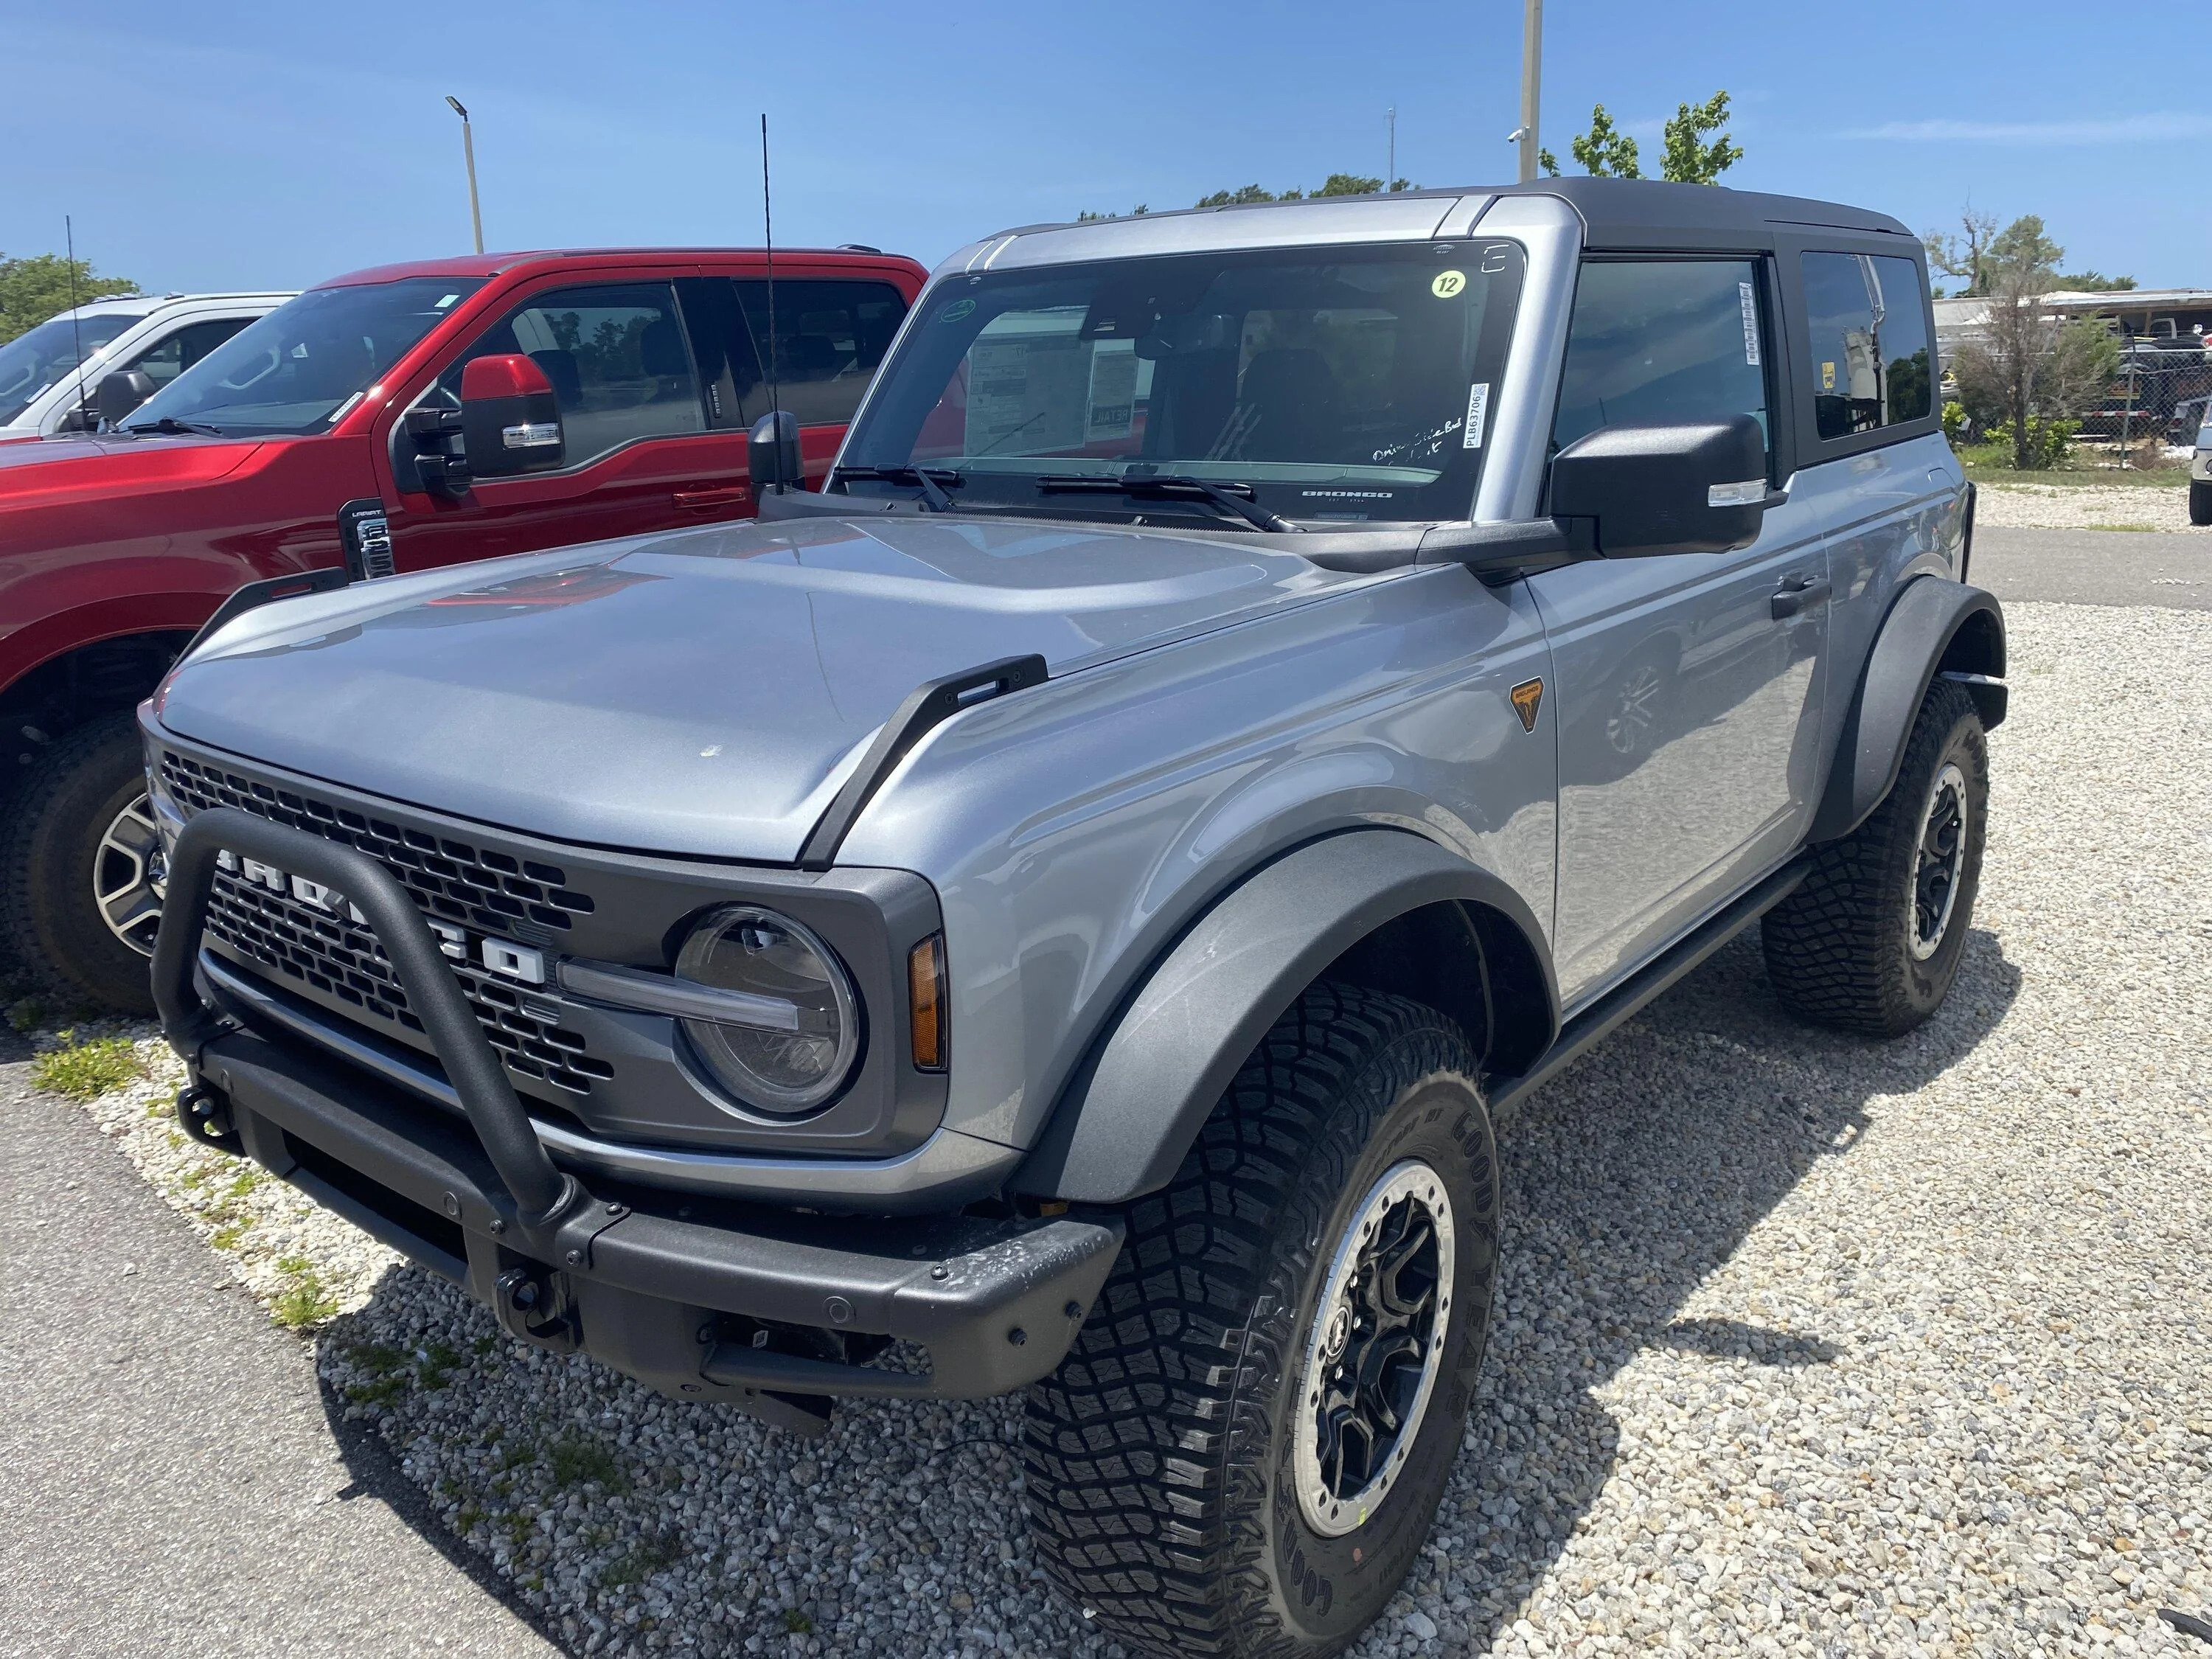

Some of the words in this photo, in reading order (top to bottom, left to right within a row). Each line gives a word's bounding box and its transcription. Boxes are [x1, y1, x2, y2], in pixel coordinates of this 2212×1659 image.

[1439, 277, 1458, 292] 12
[1467, 396, 1481, 446] PLB63706
[1447, 1109, 1500, 1420] GOODYEAR
